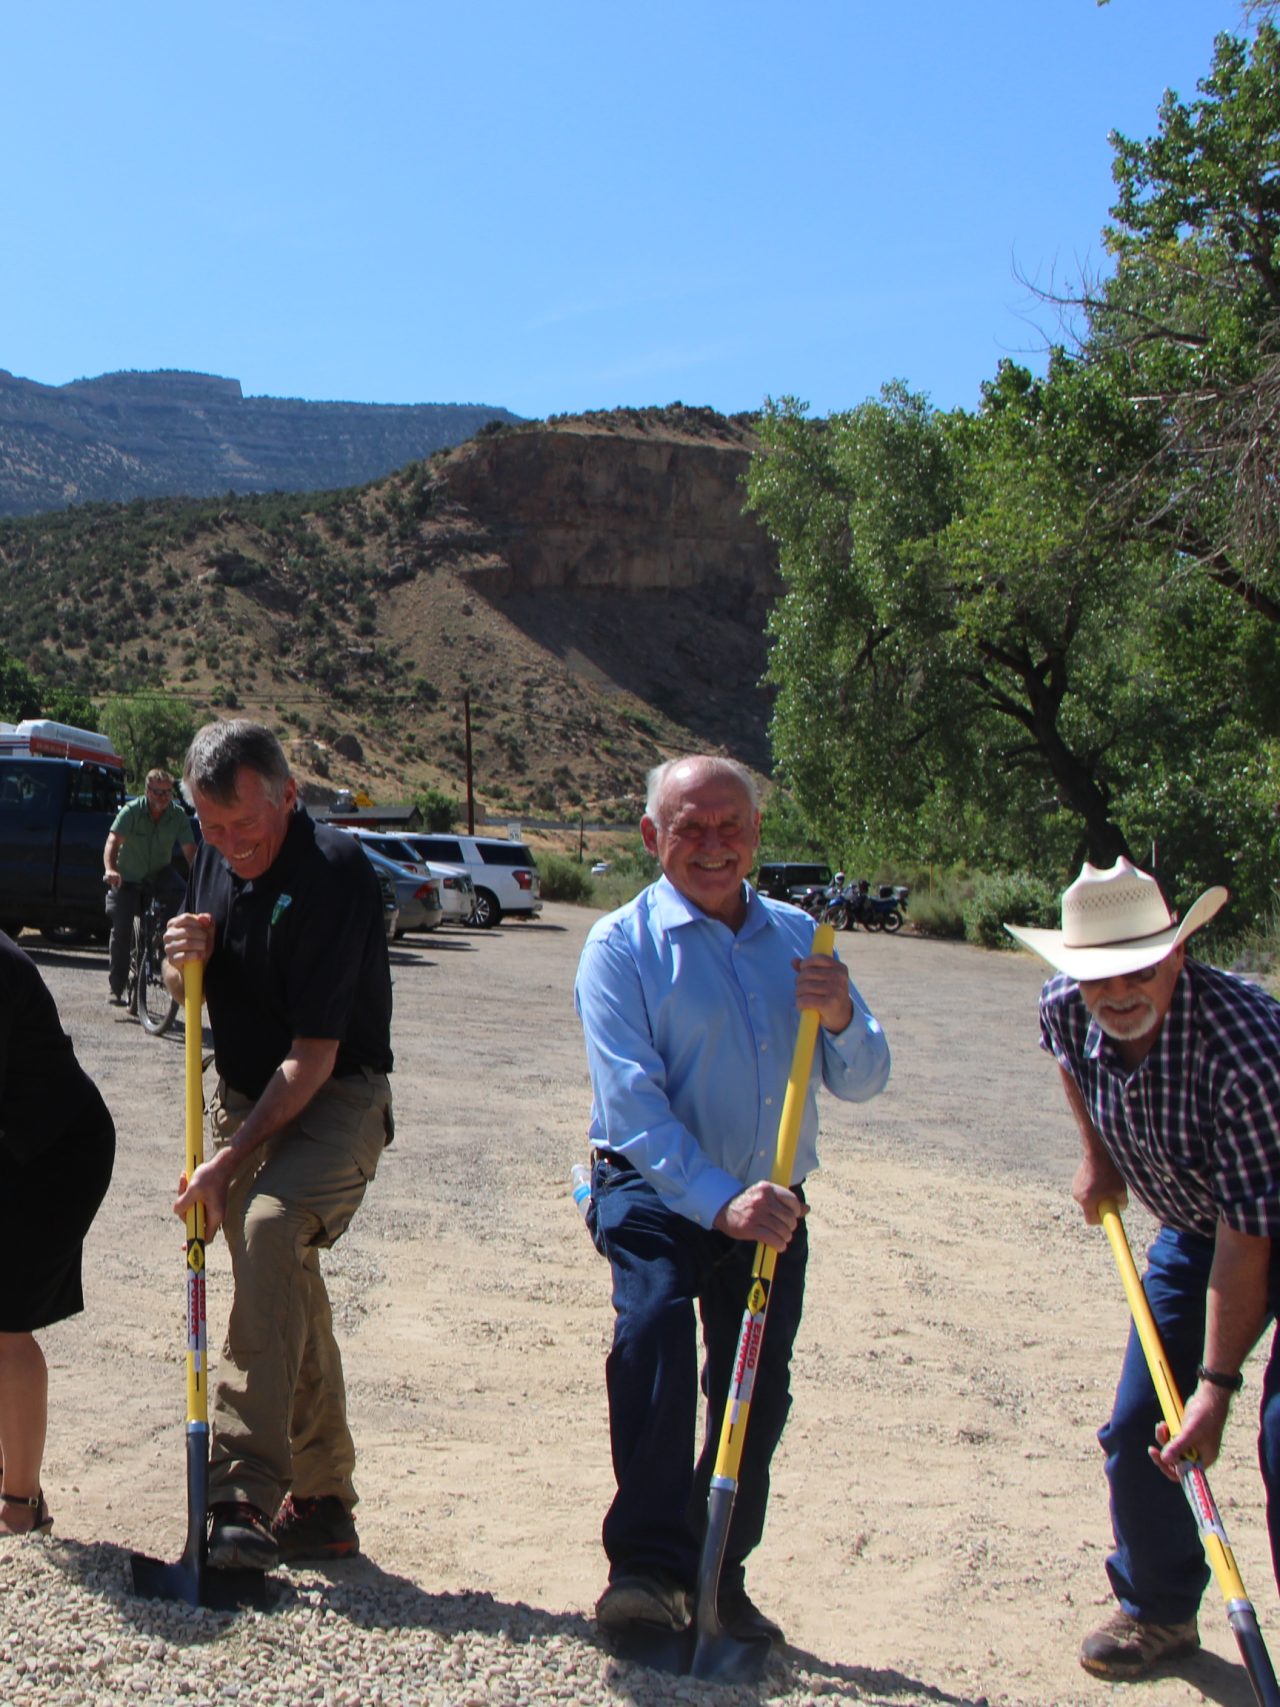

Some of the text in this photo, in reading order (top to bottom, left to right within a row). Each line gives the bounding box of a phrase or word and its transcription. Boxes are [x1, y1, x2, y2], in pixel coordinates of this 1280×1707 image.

[191, 1279, 200, 1335] POWER
[735, 1321, 753, 1383] POWER
[746, 1322, 762, 1369] ERGO
